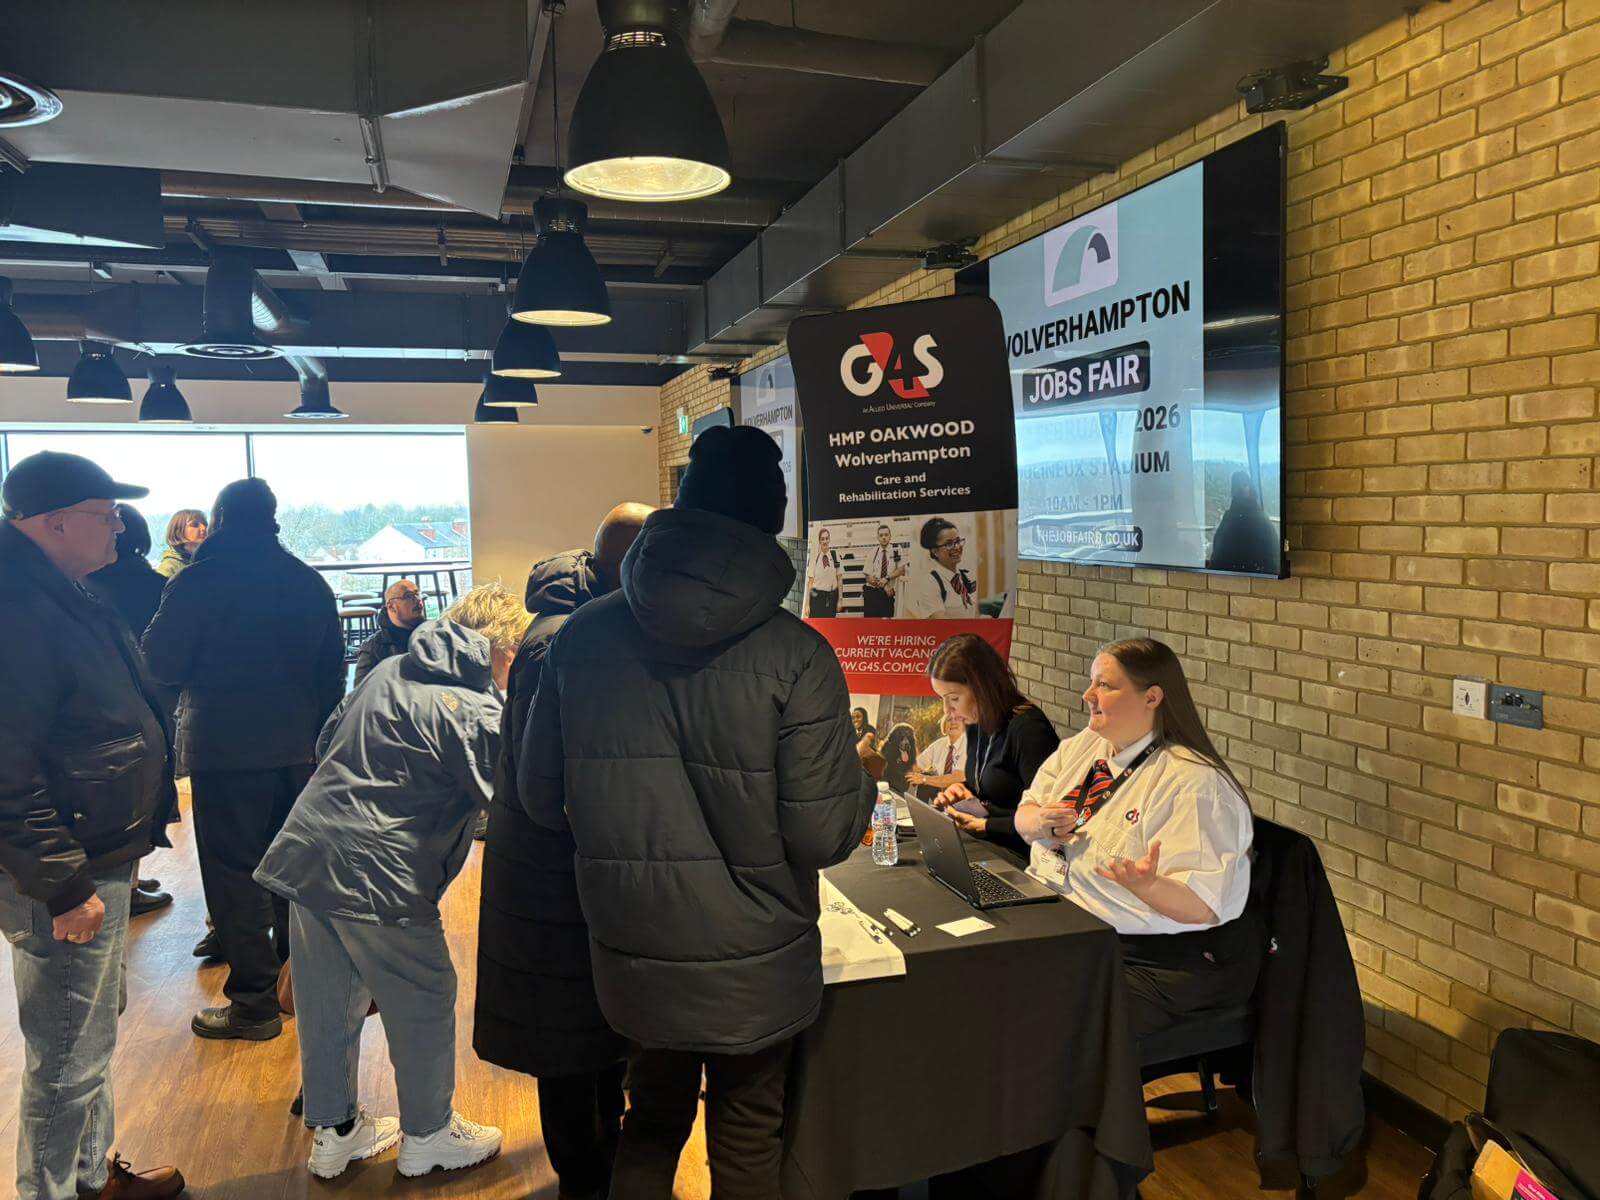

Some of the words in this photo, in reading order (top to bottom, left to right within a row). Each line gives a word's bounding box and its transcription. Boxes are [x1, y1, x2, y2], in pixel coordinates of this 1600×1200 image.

[840, 332, 944, 399] G4S
[1029, 367, 1082, 403] JOBS
[1088, 354, 1140, 393] FAIR
[1135, 404, 1181, 432] 2026
[829, 431, 866, 447] HMP
[870, 420, 975, 442] OAKWOOD
[834, 446, 971, 468] Wolverhampton
[875, 475, 902, 485] Care
[904, 472, 926, 483] and
[839, 489, 917, 503] Rehabilitation
[920, 486, 971, 498] Services
[1046, 495, 1078, 511] 10AM
[1093, 494, 1123, 510] 1PM
[857, 635, 891, 646] WE'RE
[894, 635, 936, 646] HIRING
[835, 648, 887, 658] CURRENT
